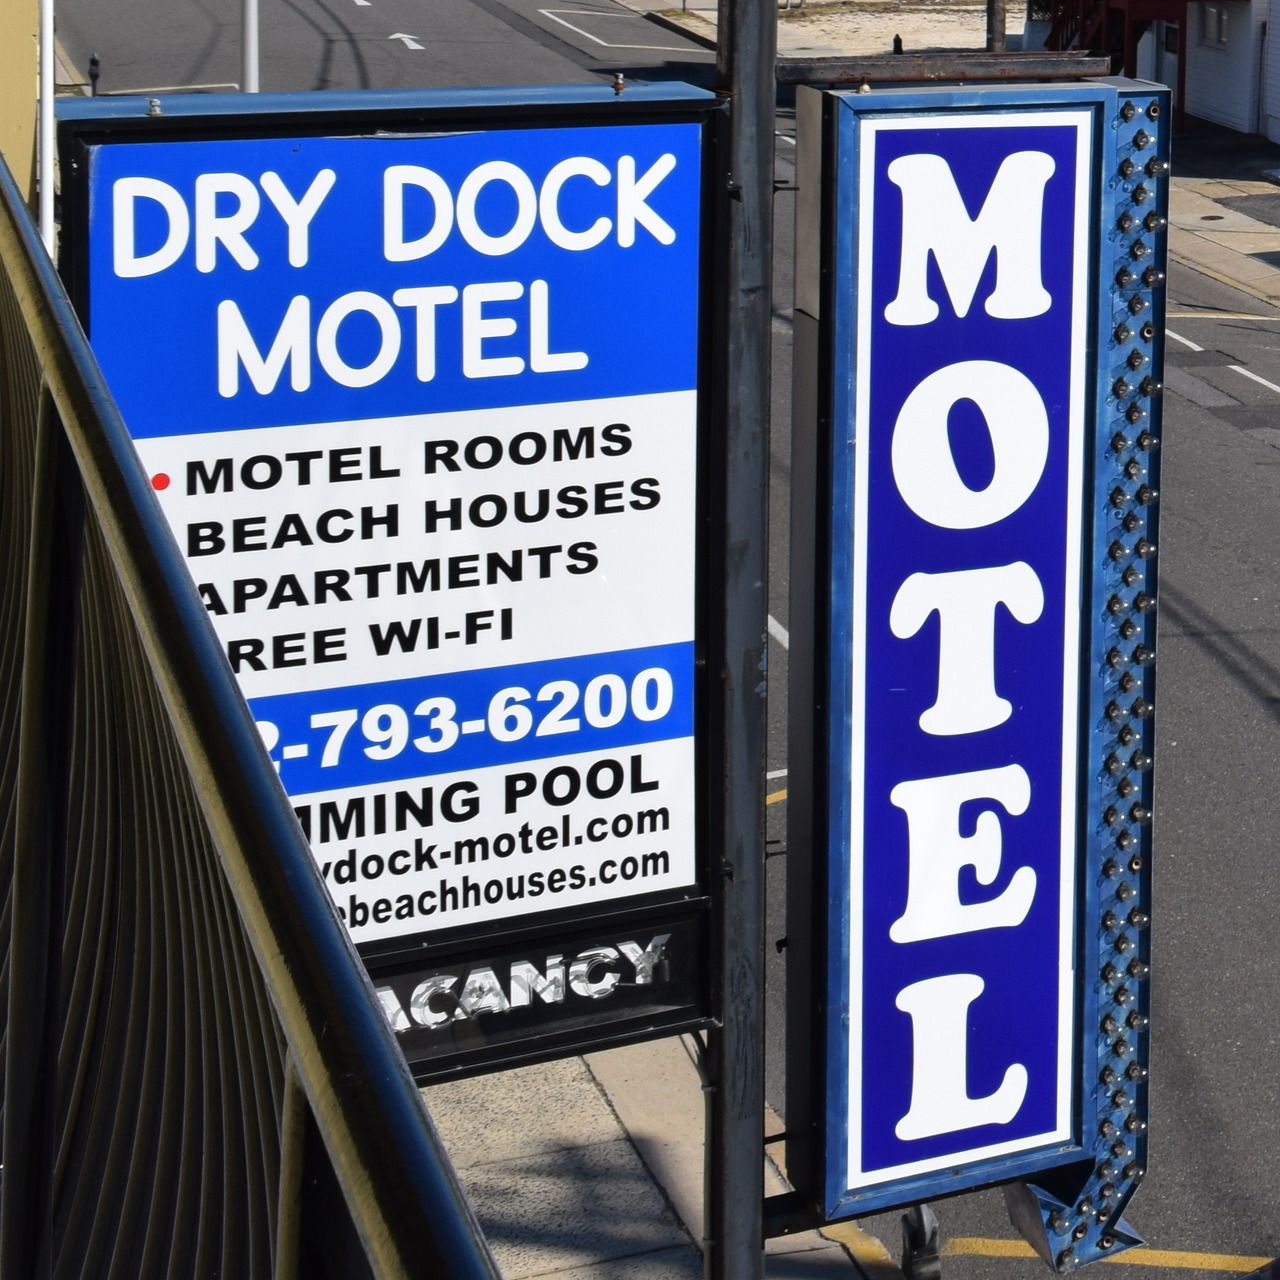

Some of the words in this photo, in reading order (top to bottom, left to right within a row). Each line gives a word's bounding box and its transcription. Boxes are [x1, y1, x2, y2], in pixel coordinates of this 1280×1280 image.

[113, 168, 336, 278] DRY
[383, 153, 677, 262] DOCK
[217, 279, 589, 398] MOTEL
[186, 445, 400, 497] MOTEL
[424, 423, 633, 475] ROOMS
[187, 503, 399, 558] BEACH
[425, 477, 661, 534] HOUSES
[201, 541, 599, 616] APARTMENTS
[227, 627, 347, 674] REE
[369, 608, 514, 657] WI-FI
[883, 150, 1057, 1142] MOTEL
[294, 781, 481, 846] MING
[504, 754, 660, 814] POOL
[375, 933, 672, 1032] ACANCY
